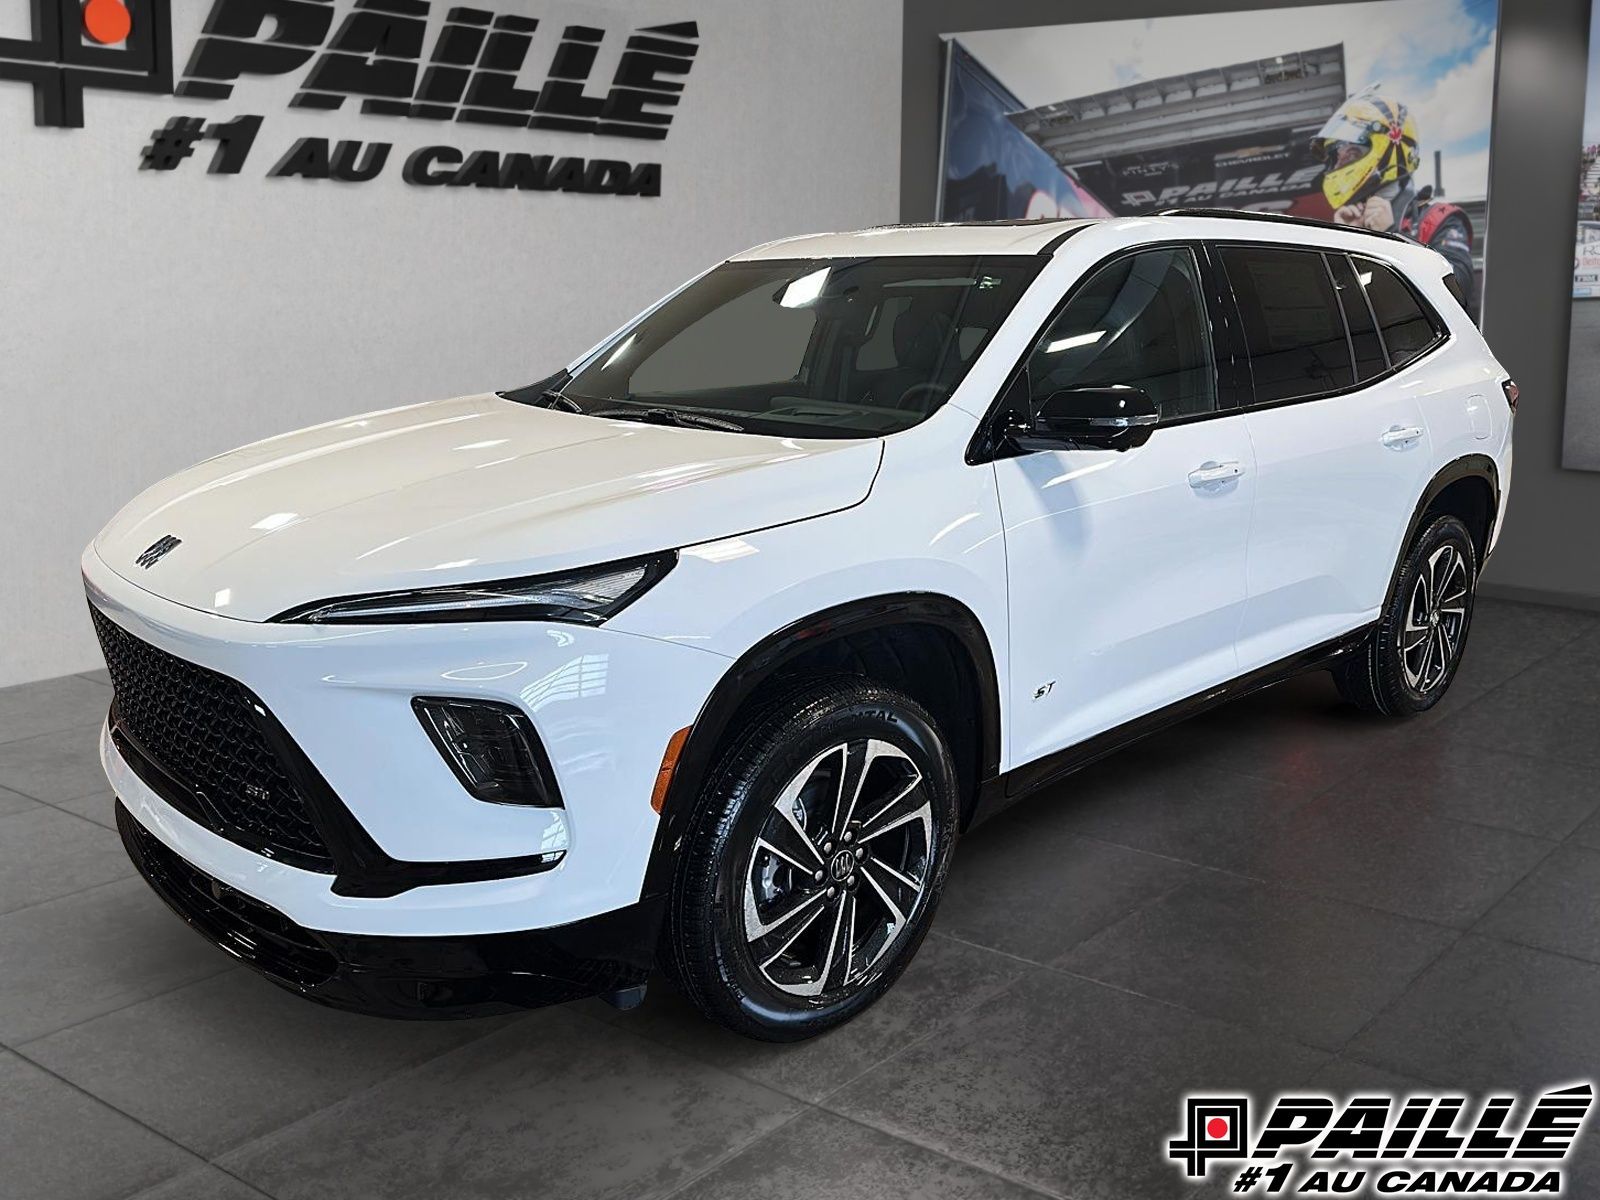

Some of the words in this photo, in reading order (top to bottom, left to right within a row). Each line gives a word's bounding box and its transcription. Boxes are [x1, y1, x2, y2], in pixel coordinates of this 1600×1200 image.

[172, 0, 699, 140] PAILLÉ
[138, 114, 264, 174] #1
[266, 136, 392, 182] AU
[401, 144, 661, 197] CANADA
